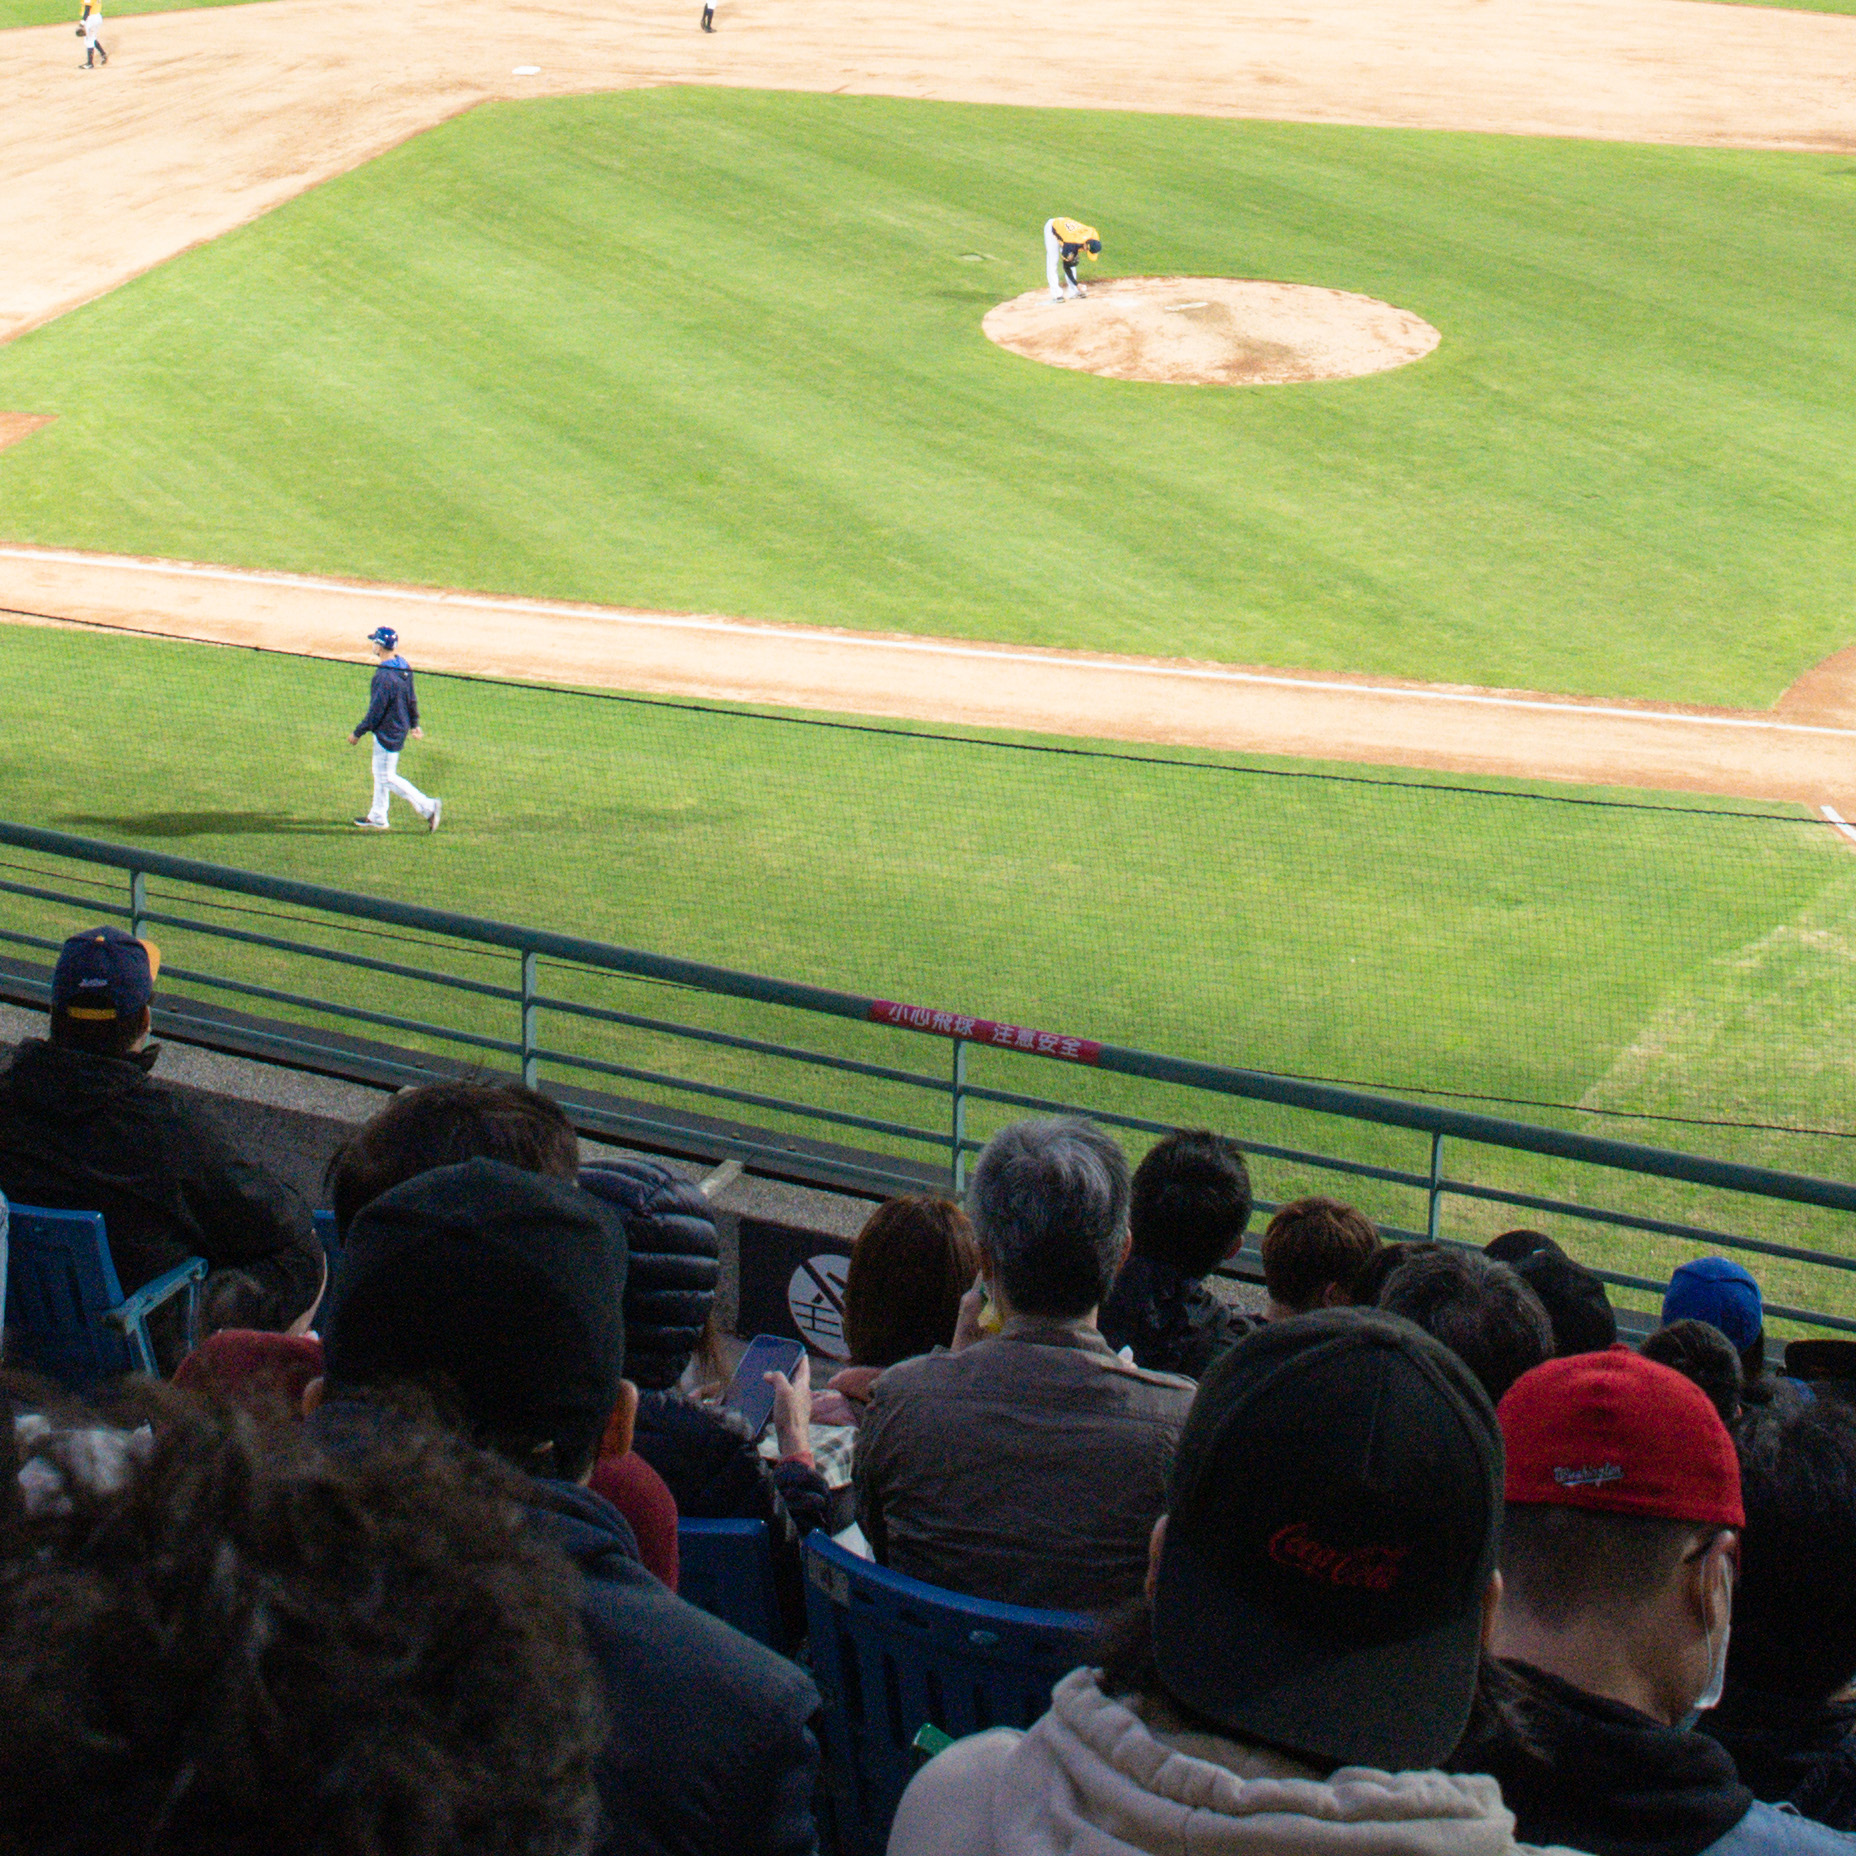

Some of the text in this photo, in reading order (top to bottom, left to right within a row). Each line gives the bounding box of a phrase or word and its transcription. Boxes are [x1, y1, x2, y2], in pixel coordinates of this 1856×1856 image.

[888, 1002, 1081, 1058] 小心飛球 注意安全
